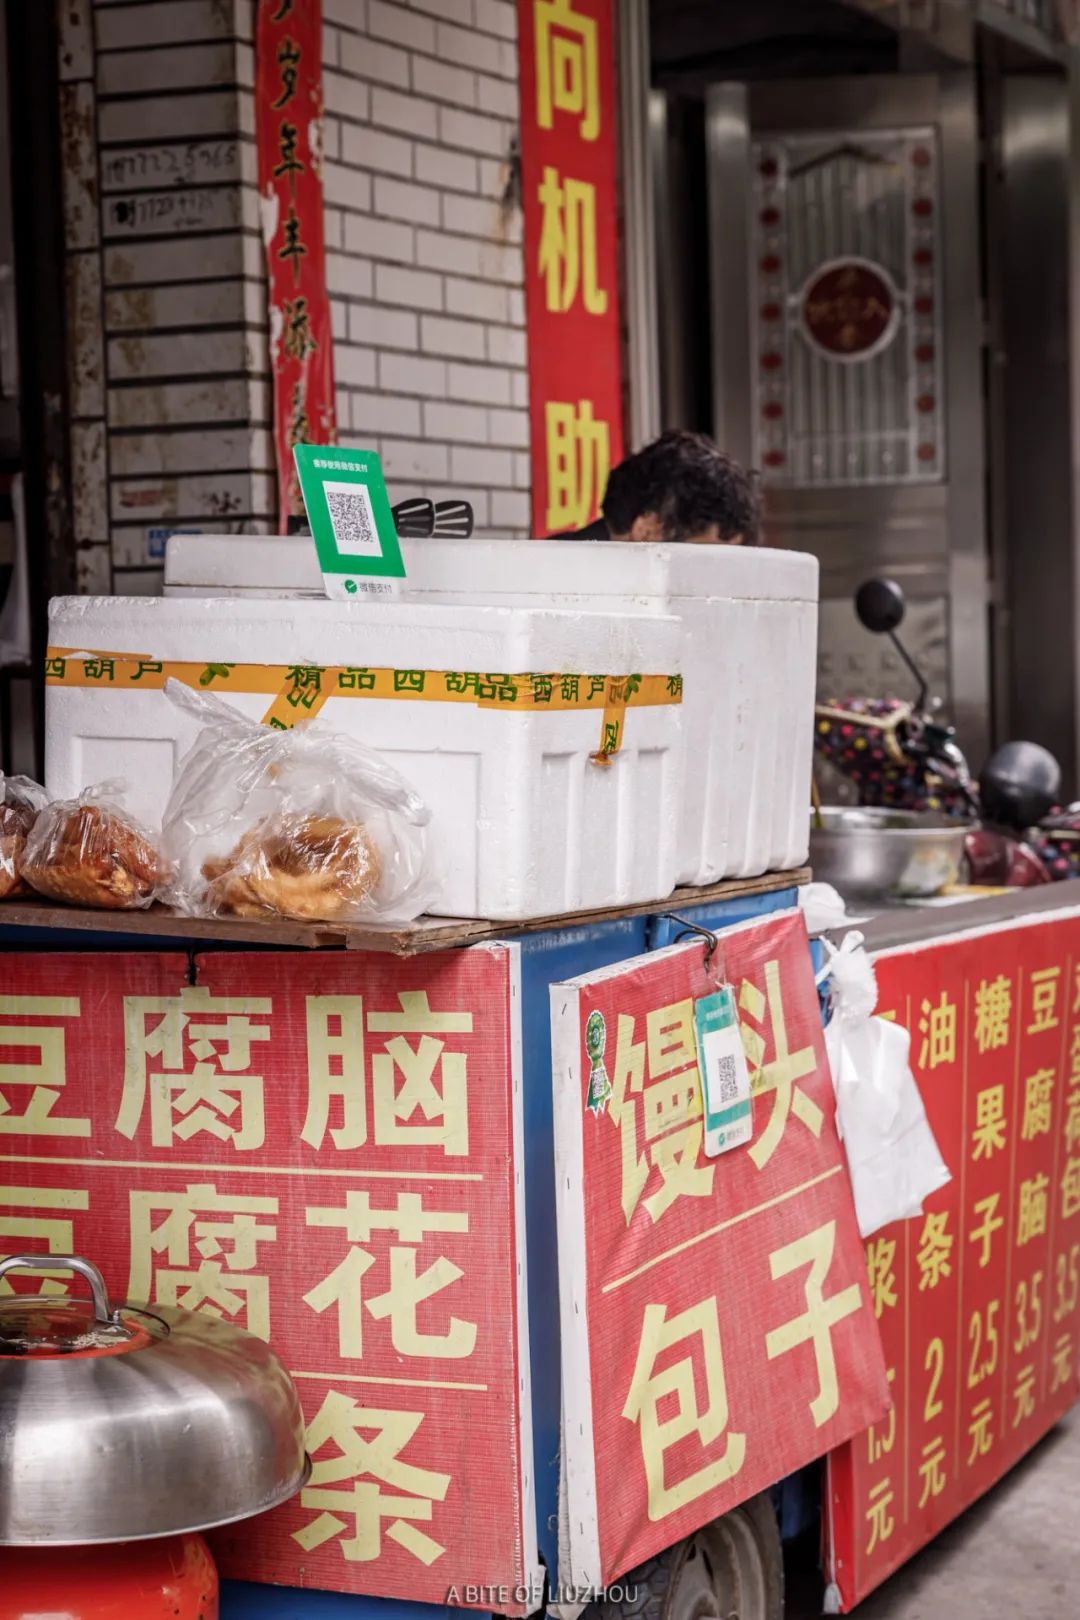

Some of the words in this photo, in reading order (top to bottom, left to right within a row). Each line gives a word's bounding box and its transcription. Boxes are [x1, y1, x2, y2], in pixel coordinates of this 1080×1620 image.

[0, 986, 474, 1157] 豆腐脑
[607, 959, 825, 1227] 馒头
[289, 1389, 452, 1567] 条
[620, 1219, 863, 1522] 包子
